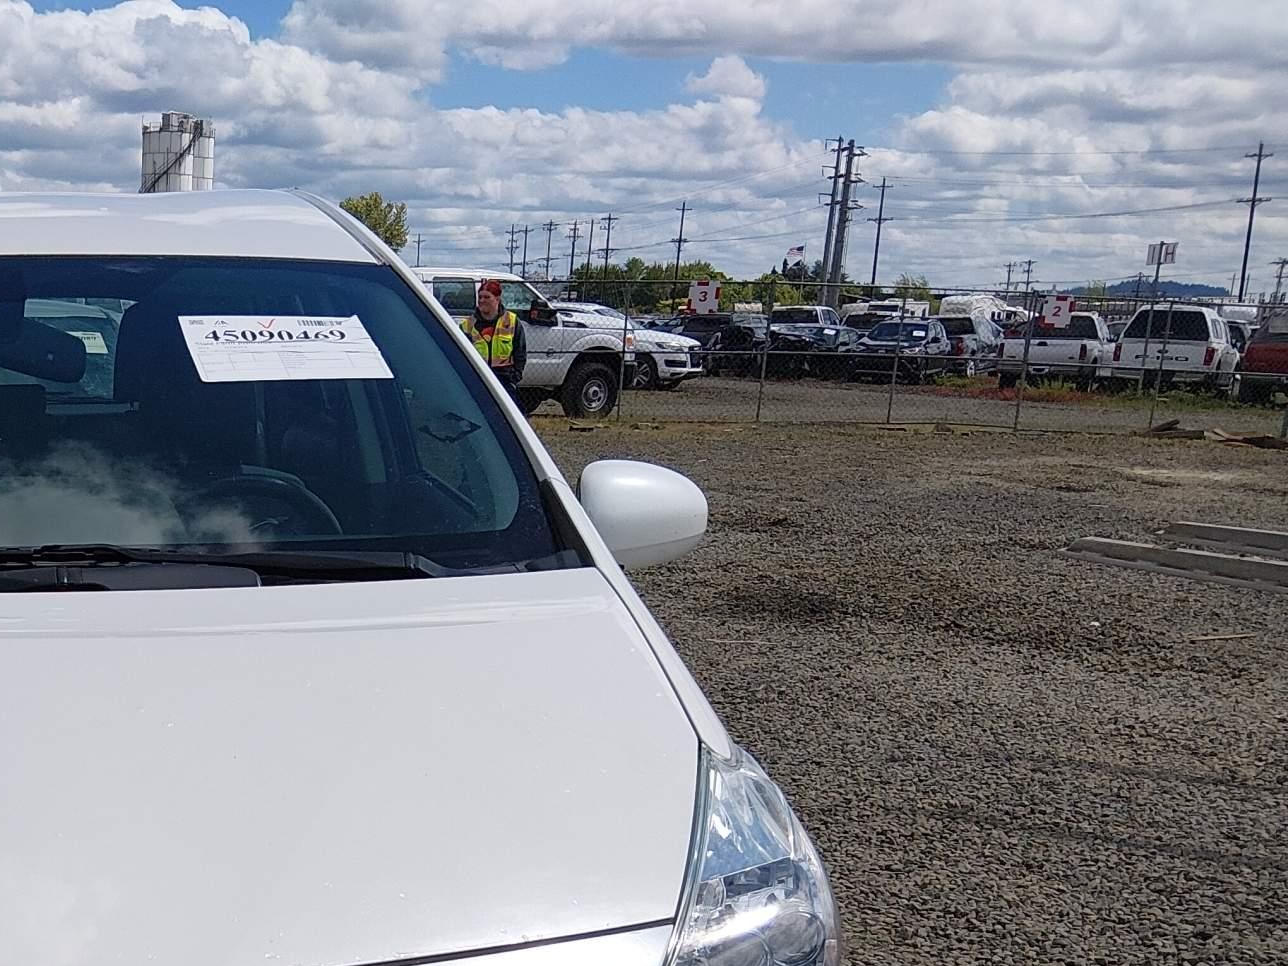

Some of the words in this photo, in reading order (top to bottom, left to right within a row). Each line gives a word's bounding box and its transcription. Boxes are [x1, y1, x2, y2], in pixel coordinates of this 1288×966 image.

[1164, 244, 1177, 262] H
[698, 290, 708, 302] 3
[1051, 305, 1062, 317] 2
[204, 329, 347, 342] 45090469
